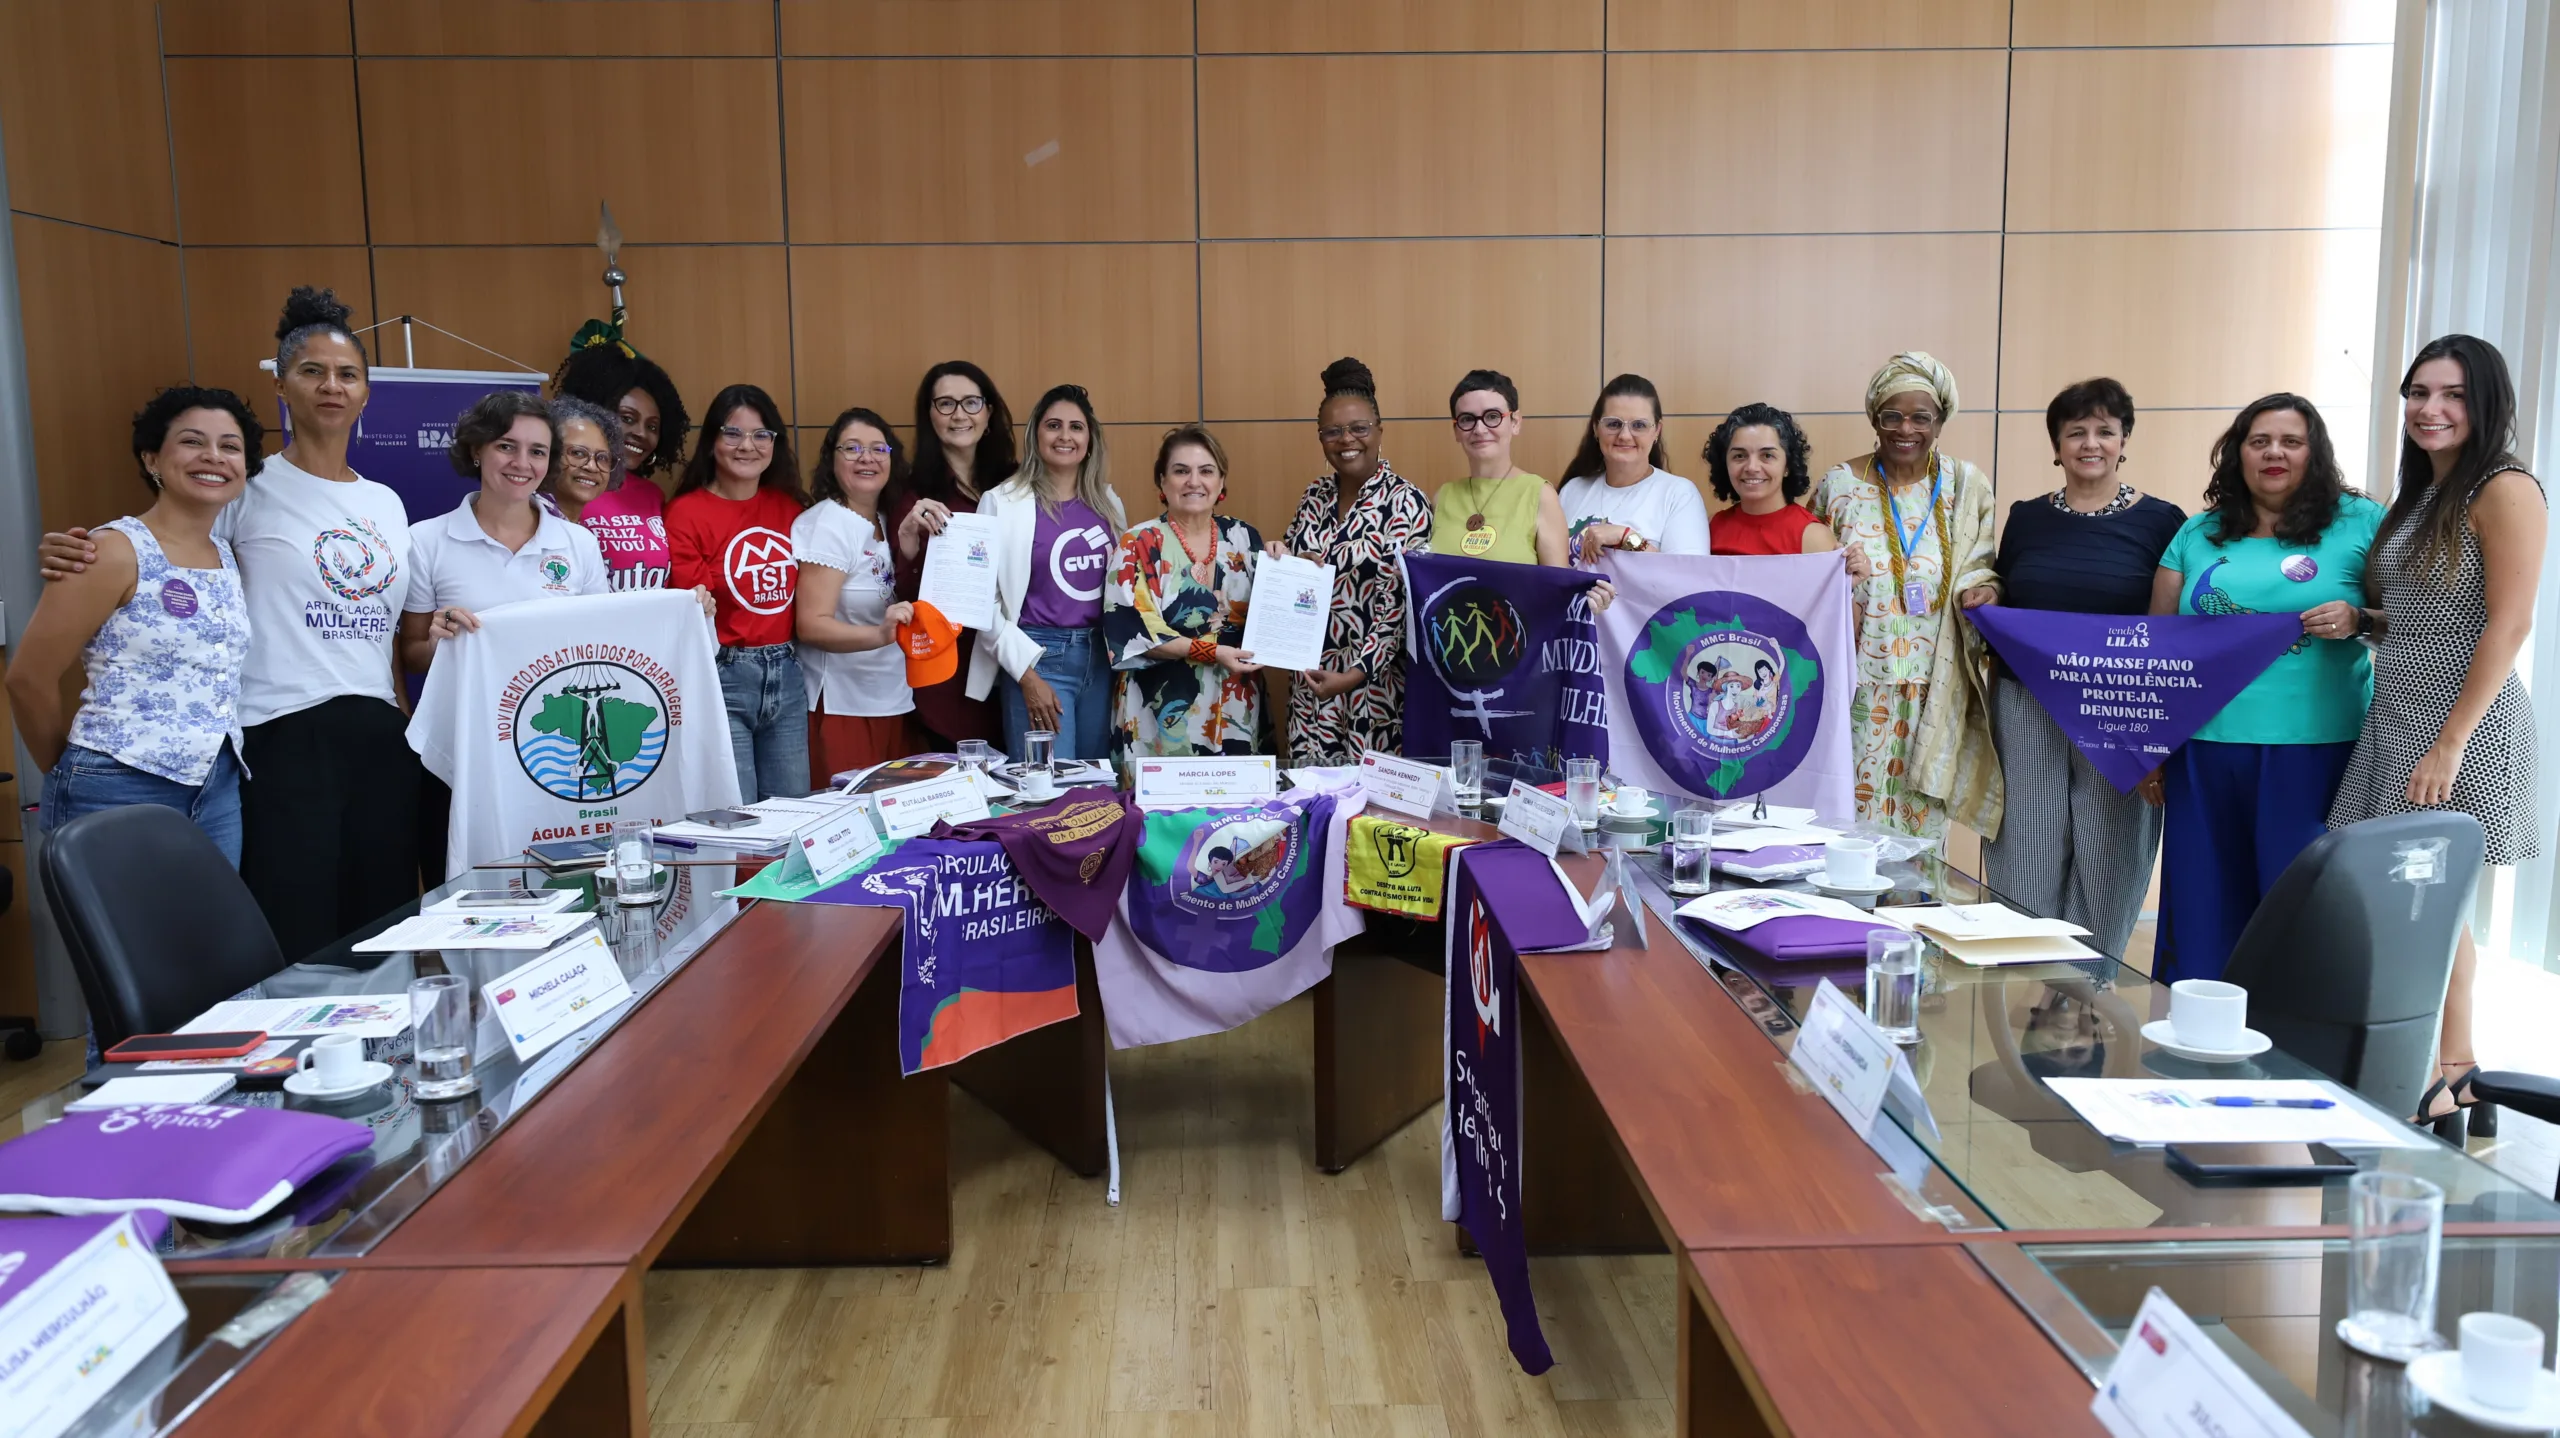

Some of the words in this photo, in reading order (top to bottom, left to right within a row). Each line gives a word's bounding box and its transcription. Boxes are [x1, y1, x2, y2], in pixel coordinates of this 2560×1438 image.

[612, 515, 645, 527] SER
[610, 541, 645, 552] VOU
[1064, 554, 1103, 572] CUT
[753, 589, 789, 604] BRASIL
[2108, 626, 2135, 636] tenda
[1700, 633, 1726, 648] MMC
[1728, 632, 1762, 647] Brasil
[2106, 634, 2150, 648] LILÁS
[2056, 651, 2090, 667] NÃO
[2092, 656, 2144, 670] PASSE
[2147, 658, 2194, 671] PANO
[2049, 669, 2091, 683] PARA
[2092, 673, 2103, 684] A
[2105, 671, 2203, 689] VIOLÊNCIA.
[497, 670, 534, 742] MOVIMENTO
[528, 654, 556, 677] DOS
[624, 649, 651, 672] POR
[643, 661, 682, 726] BARRAGENS
[2082, 687, 2164, 704] PROTEJA.
[2080, 703, 2170, 721] DENUNCIE.
[1672, 690, 1697, 740] Movimento
[1697, 737, 1708, 748] de
[1708, 743, 1752, 754] Mulheres
[1751, 694, 1789, 748] Camponesas
[2097, 720, 2127, 732] Ligue
[2128, 722, 2150, 733] 180.
[1377, 766, 1397, 777] SANDRA
[1397, 771, 1421, 782] KENNEDY
[579, 806, 618, 819] Brasil
[1210, 814, 1242, 830] MMC
[531, 827, 576, 842] ÁGUA
[581, 824, 590, 836] E
[1218, 901, 1233, 910] de
[1234, 880, 1280, 910] Mulheres
[1276, 820, 1298, 880] Campones
[1360, 888, 1382, 897] CONTRA
[528, 977, 561, 1000] MICHELA
[559, 963, 588, 983] CALAÇA
